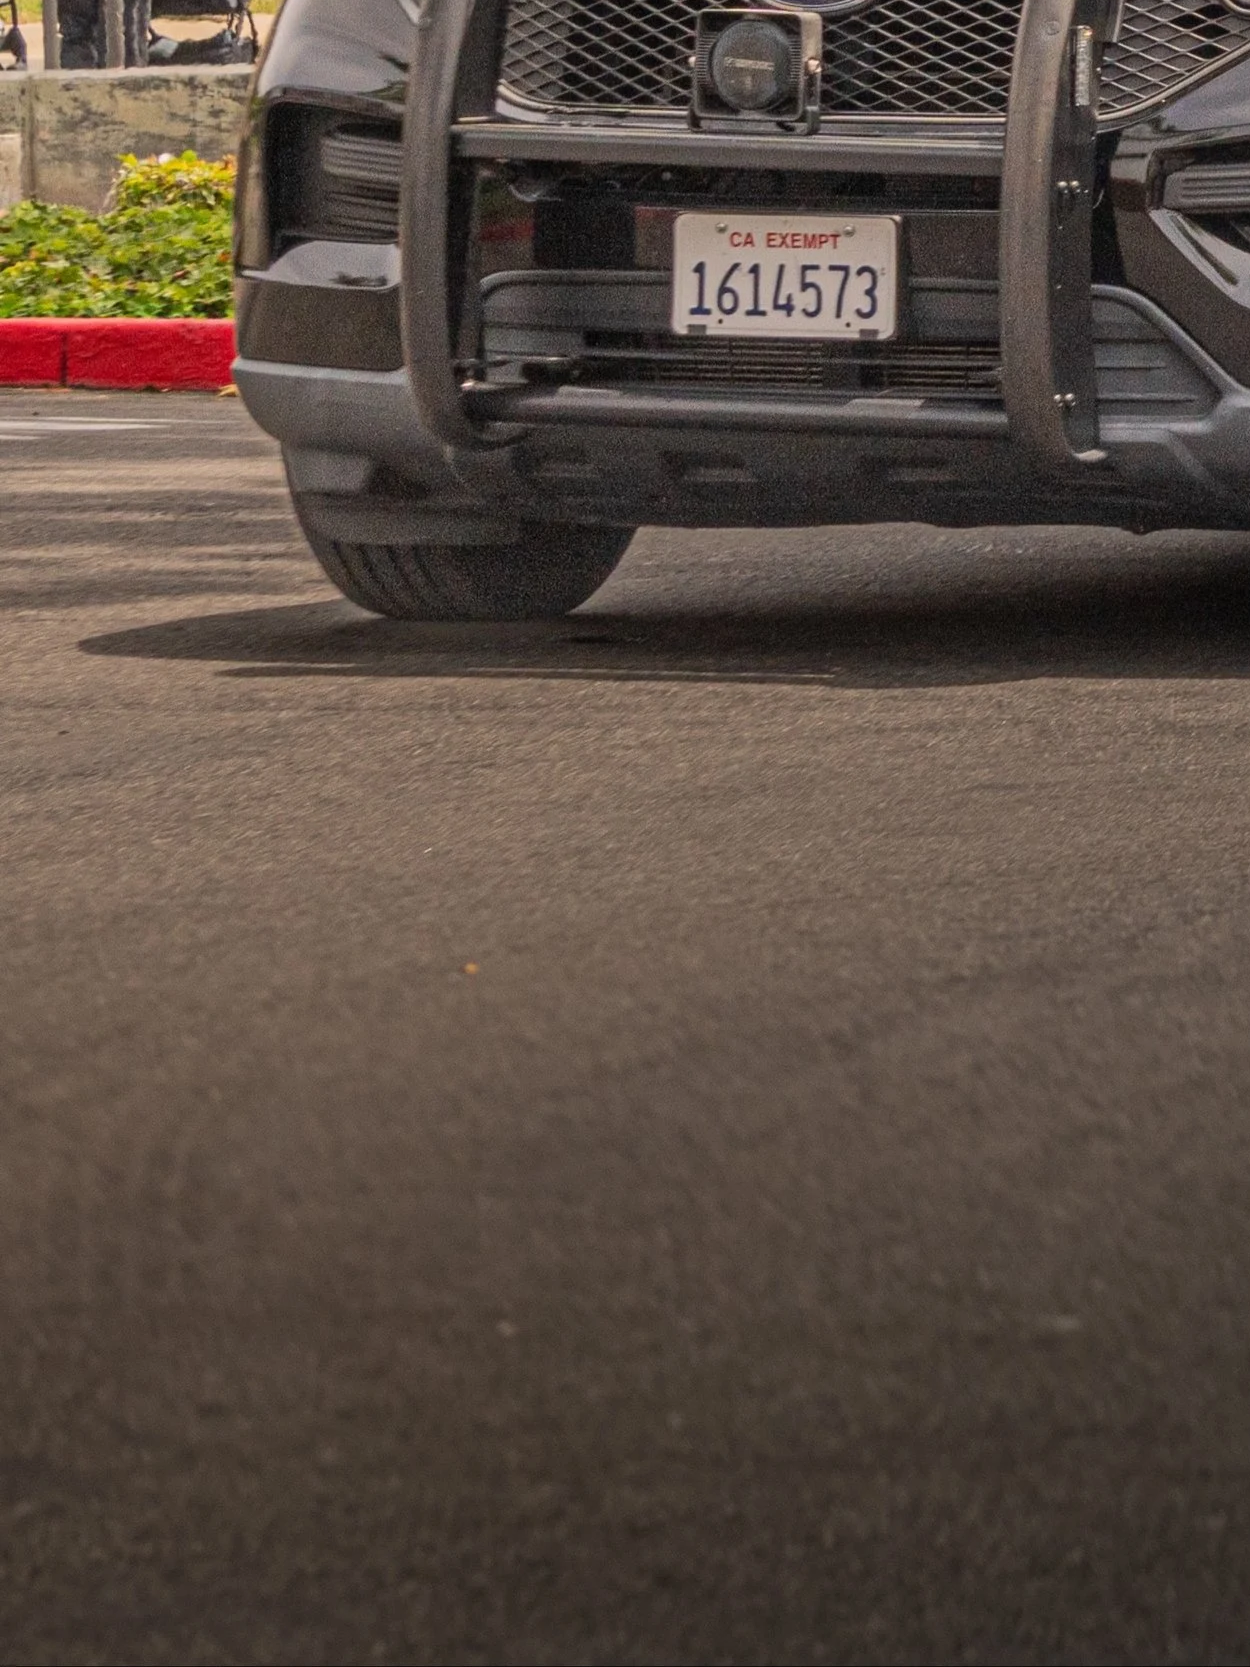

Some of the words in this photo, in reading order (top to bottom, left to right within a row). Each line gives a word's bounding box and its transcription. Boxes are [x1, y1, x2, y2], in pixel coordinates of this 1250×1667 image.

[730, 232, 754, 248] CA
[767, 232, 841, 250] EXEMPT
[689, 260, 879, 319] 1614573
